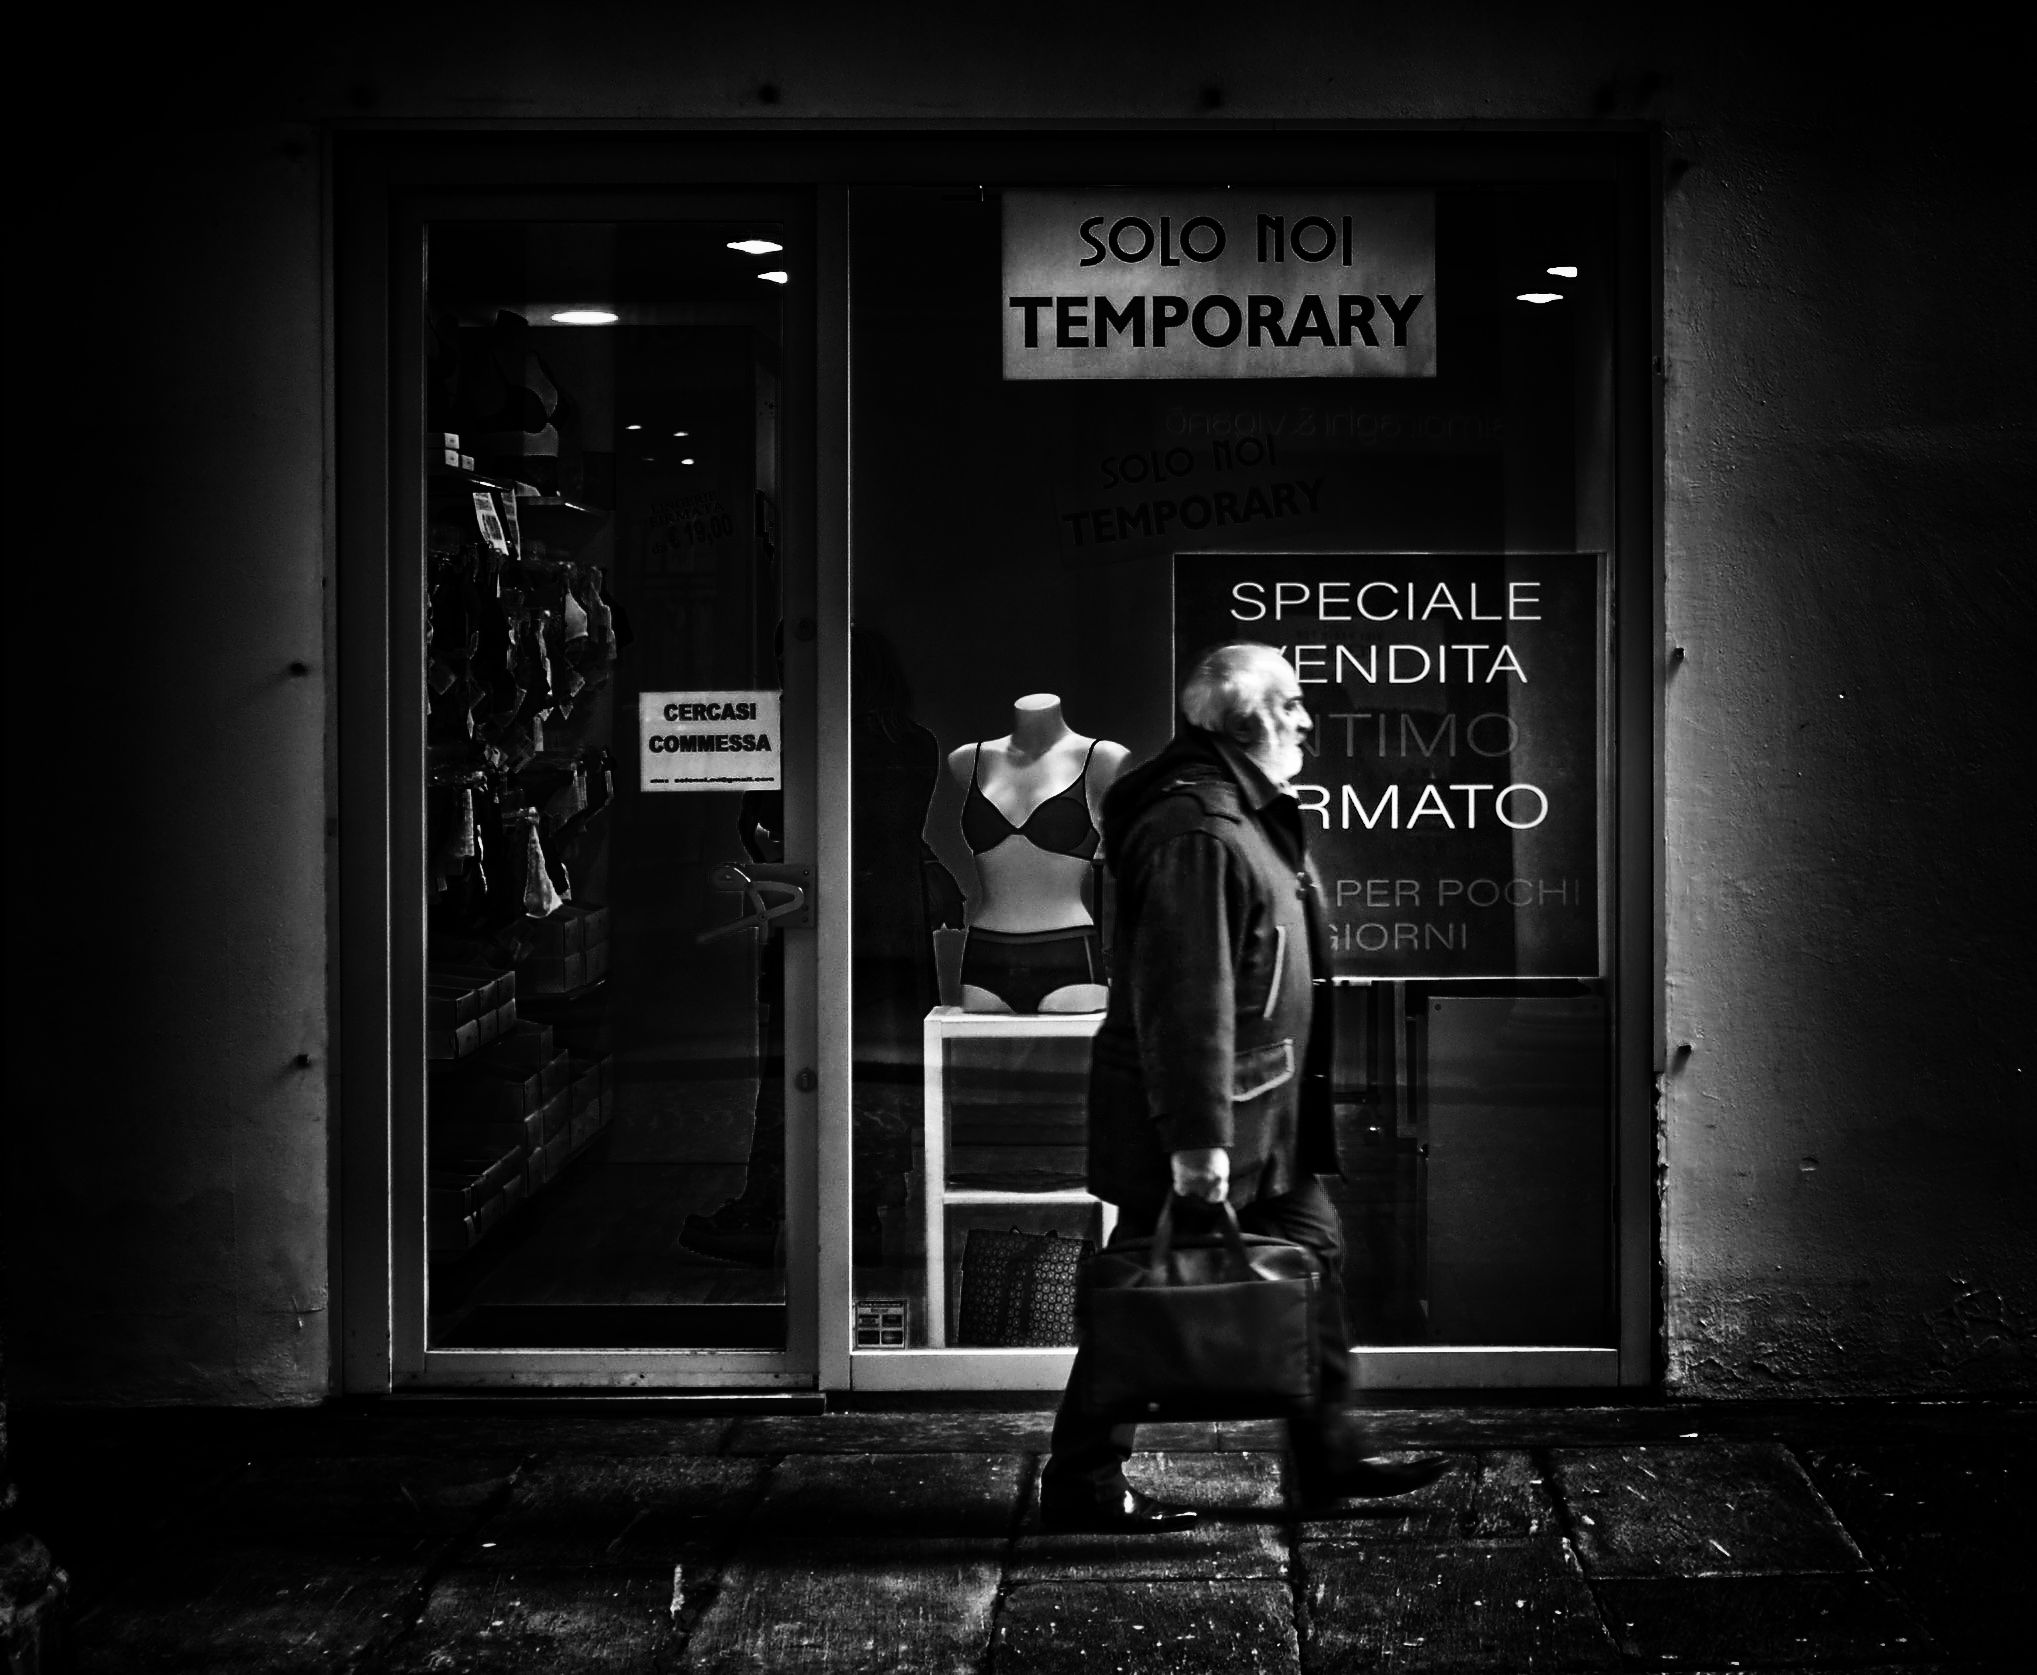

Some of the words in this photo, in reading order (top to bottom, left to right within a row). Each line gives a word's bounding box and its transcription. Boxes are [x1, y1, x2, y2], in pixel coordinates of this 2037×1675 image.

[1080, 216, 1227, 267] SOLO
[1256, 213, 1353, 267] NOI
[1009, 294, 1424, 348] TEMPORARY
[1100, 446, 1195, 490] SOLO
[1212, 433, 1277, 472] NOI
[1061, 475, 1326, 547] TEMPORARY
[1229, 581, 1543, 622] SPECIALE
[663, 702, 757, 722] CERCASI
[1300, 712, 1521, 758] NTIMO
[648, 733, 773, 753] COMMESSA
[1296, 783, 1550, 831] RMATO
[1336, 878, 1421, 907] PER
[1438, 878, 1582, 908] POCHI
